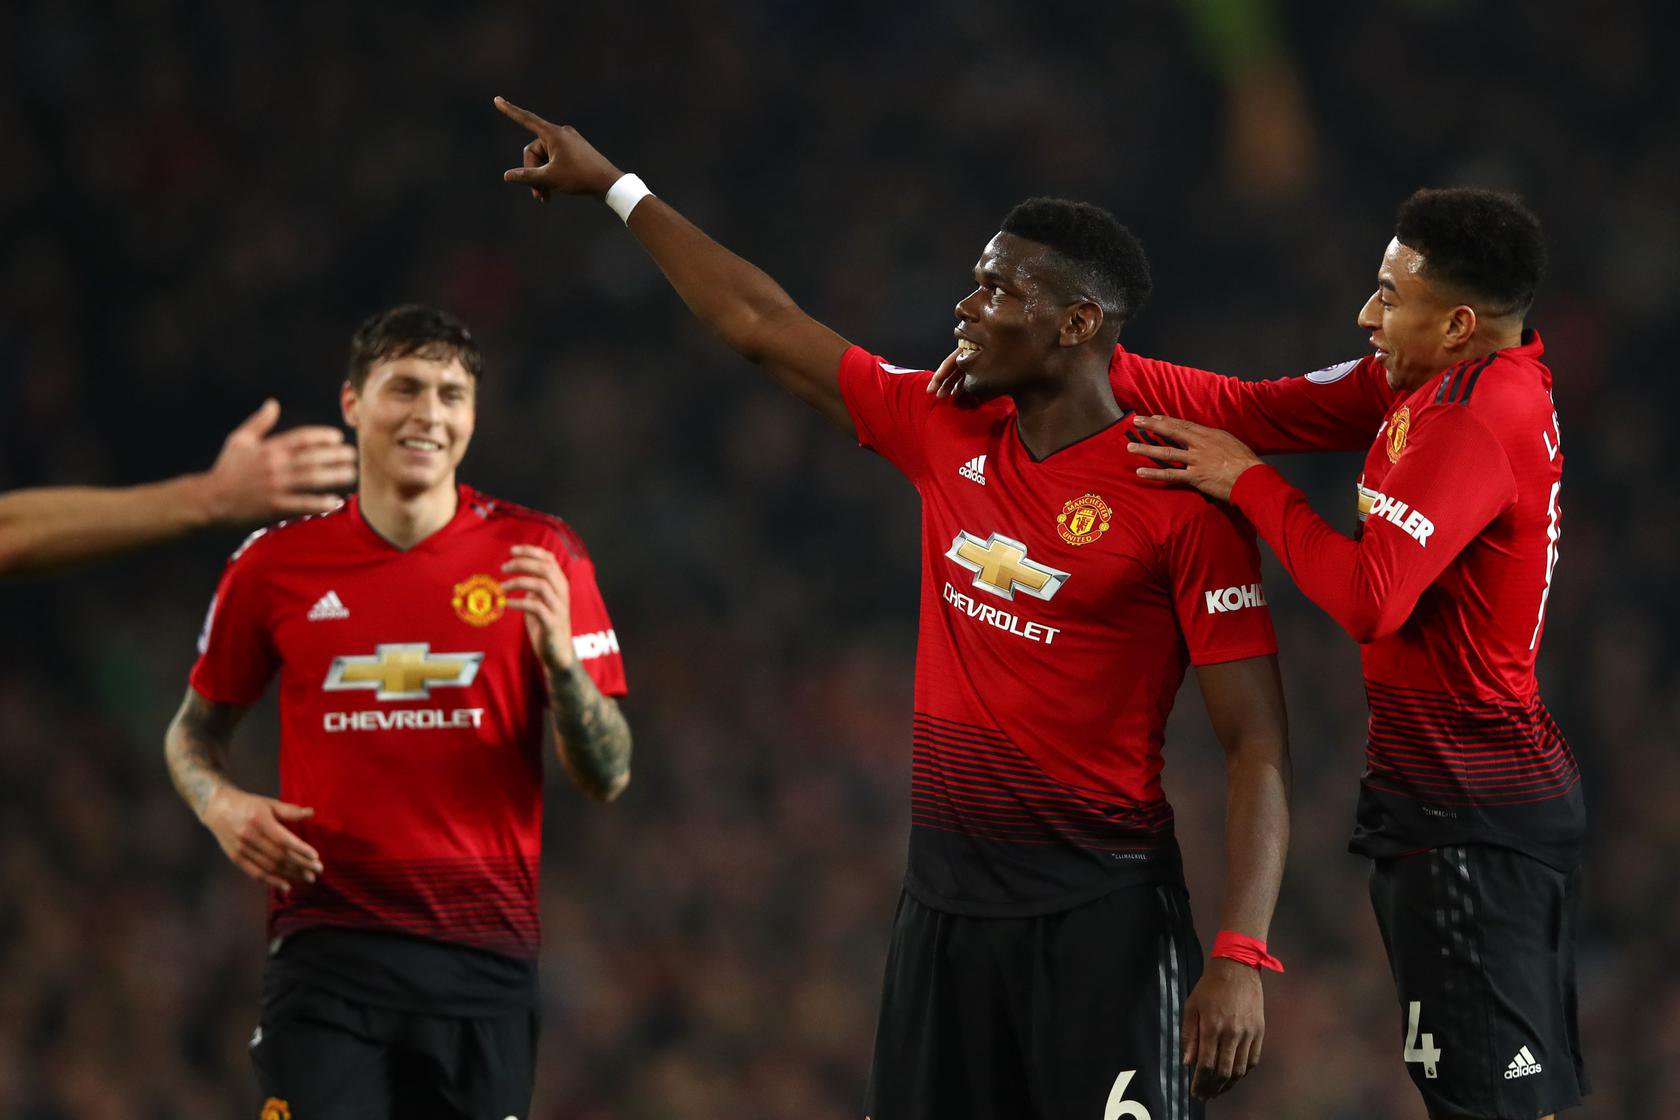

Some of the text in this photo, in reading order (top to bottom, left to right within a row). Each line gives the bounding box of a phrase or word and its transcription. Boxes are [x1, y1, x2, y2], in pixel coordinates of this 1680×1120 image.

[958, 466, 986, 486] adidas
[1067, 497, 1108, 519] MANCHESTER
[1062, 531, 1092, 542] UNITED
[943, 581, 1061, 645] CHEVROLET
[323, 708, 484, 732] CHEVROLET
[1403, 1000, 1442, 1079] 4
[1504, 1063, 1542, 1080] adidas
